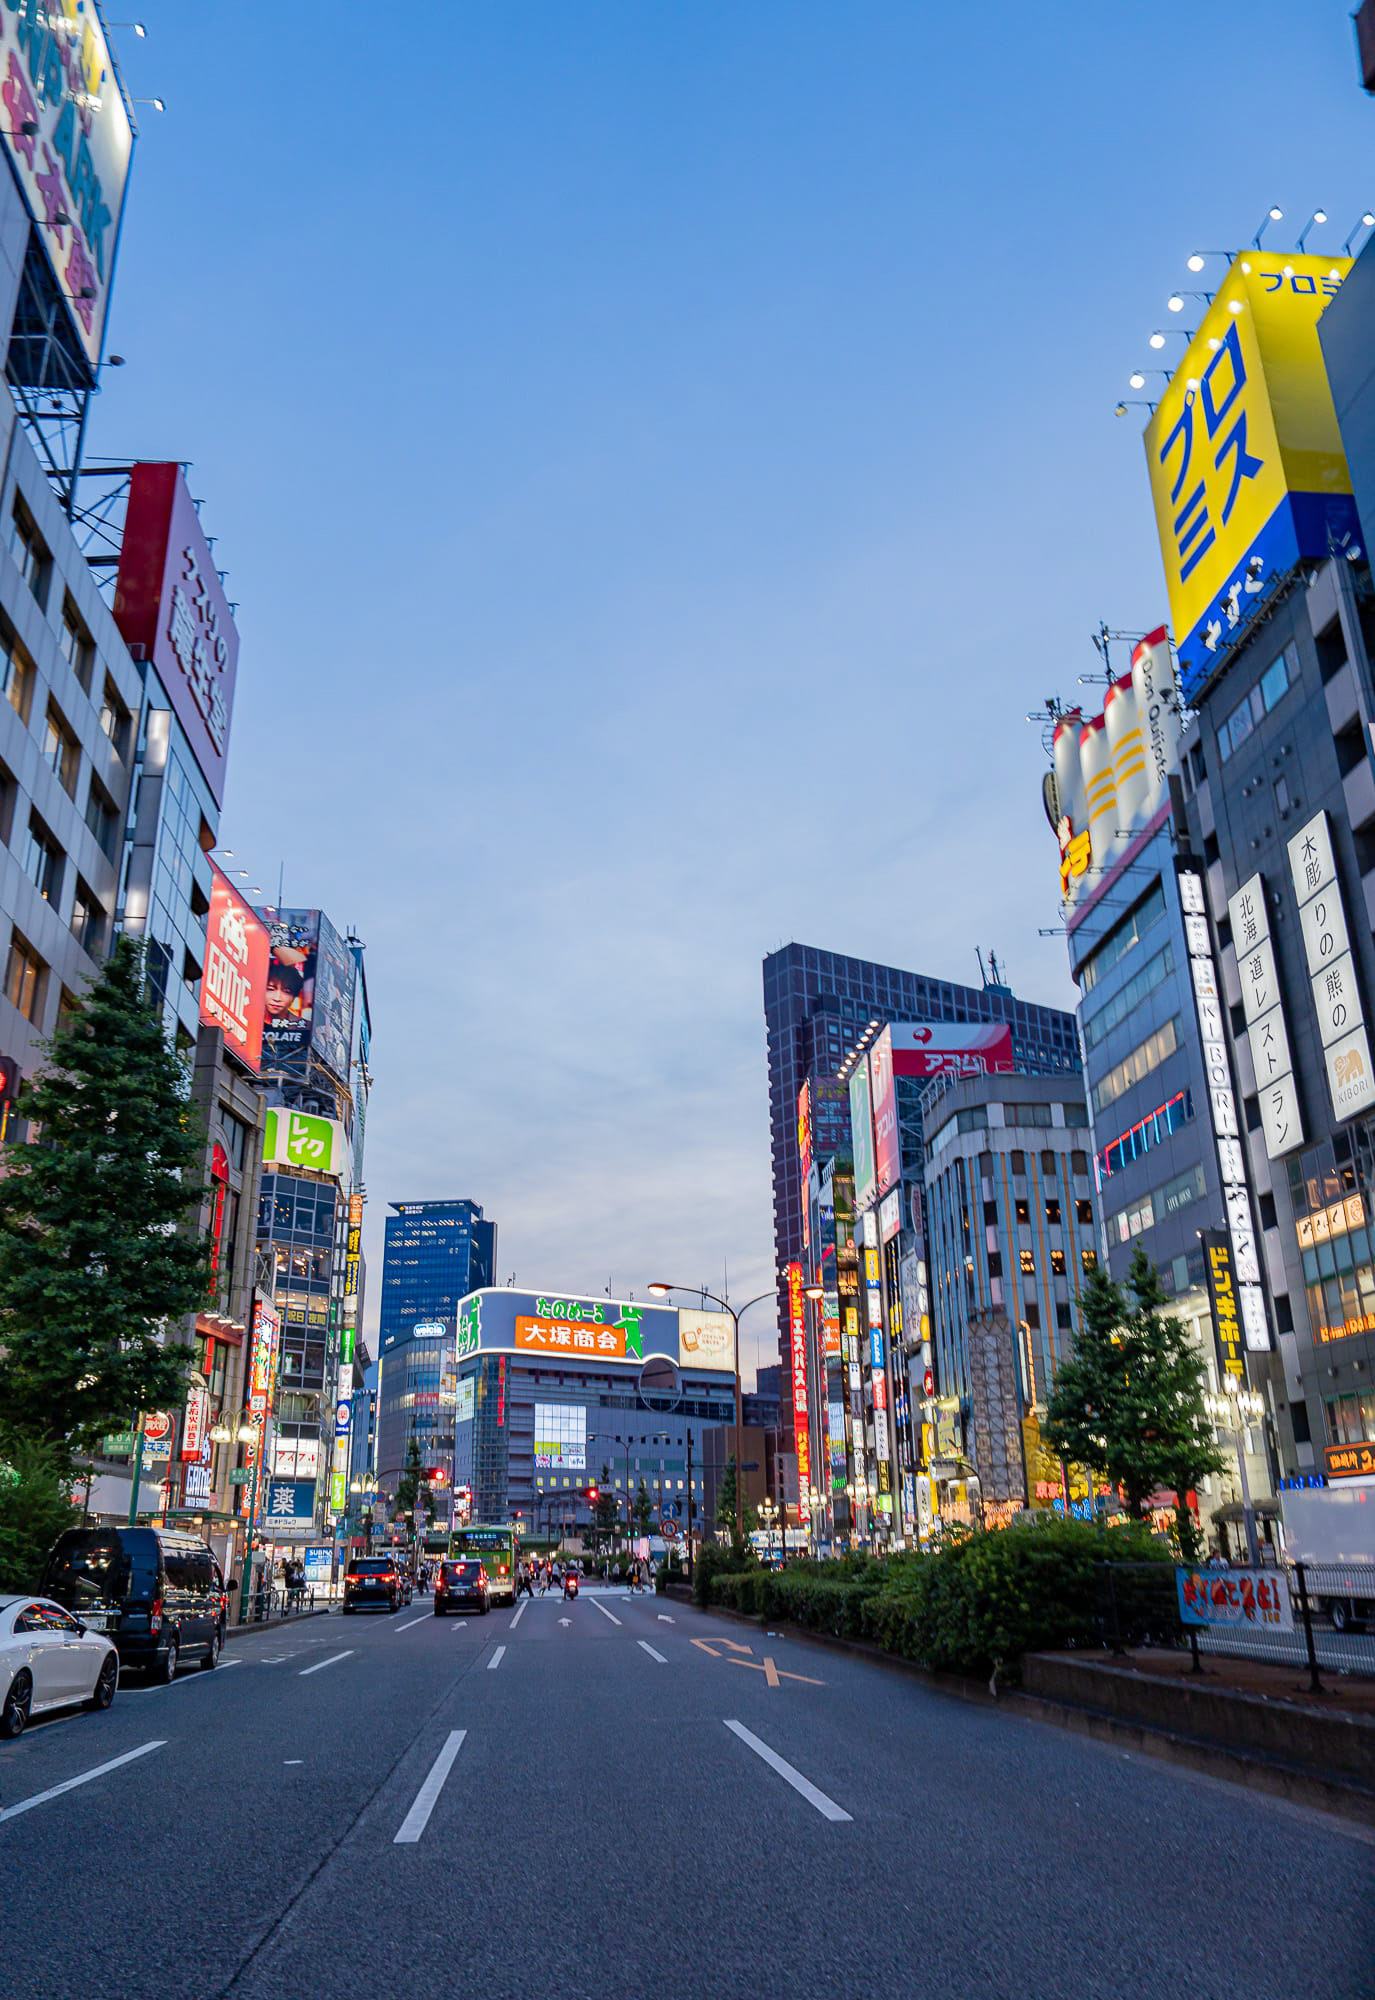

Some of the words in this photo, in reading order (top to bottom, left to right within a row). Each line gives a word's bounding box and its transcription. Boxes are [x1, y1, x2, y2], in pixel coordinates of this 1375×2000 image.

[1160, 320, 1247, 507] プロ
[1173, 409, 1265, 585] ミス
[182, 545, 229, 674] クスリの
[1142, 659, 1154, 709] Don
[1148, 704, 1168, 785] Quijote
[1301, 835, 1348, 1029] 木彫りの熊の
[207, 941, 251, 1027] GAME
[1239, 893, 1290, 1146] 北海道レストラン
[924, 1053, 985, 1073] アコム
[1201, 1001, 1230, 1130] KIBORI
[1337, 1079, 1370, 1106] KIBORI
[289, 1138, 325, 1157] イク
[292, 1115, 309, 1135] レ
[876, 1110, 894, 1145] アコム
[525, 1324, 618, 1351] 大塚商会
[536, 1297, 606, 1323] たのめーる
[271, 1486, 296, 1515] 薬
